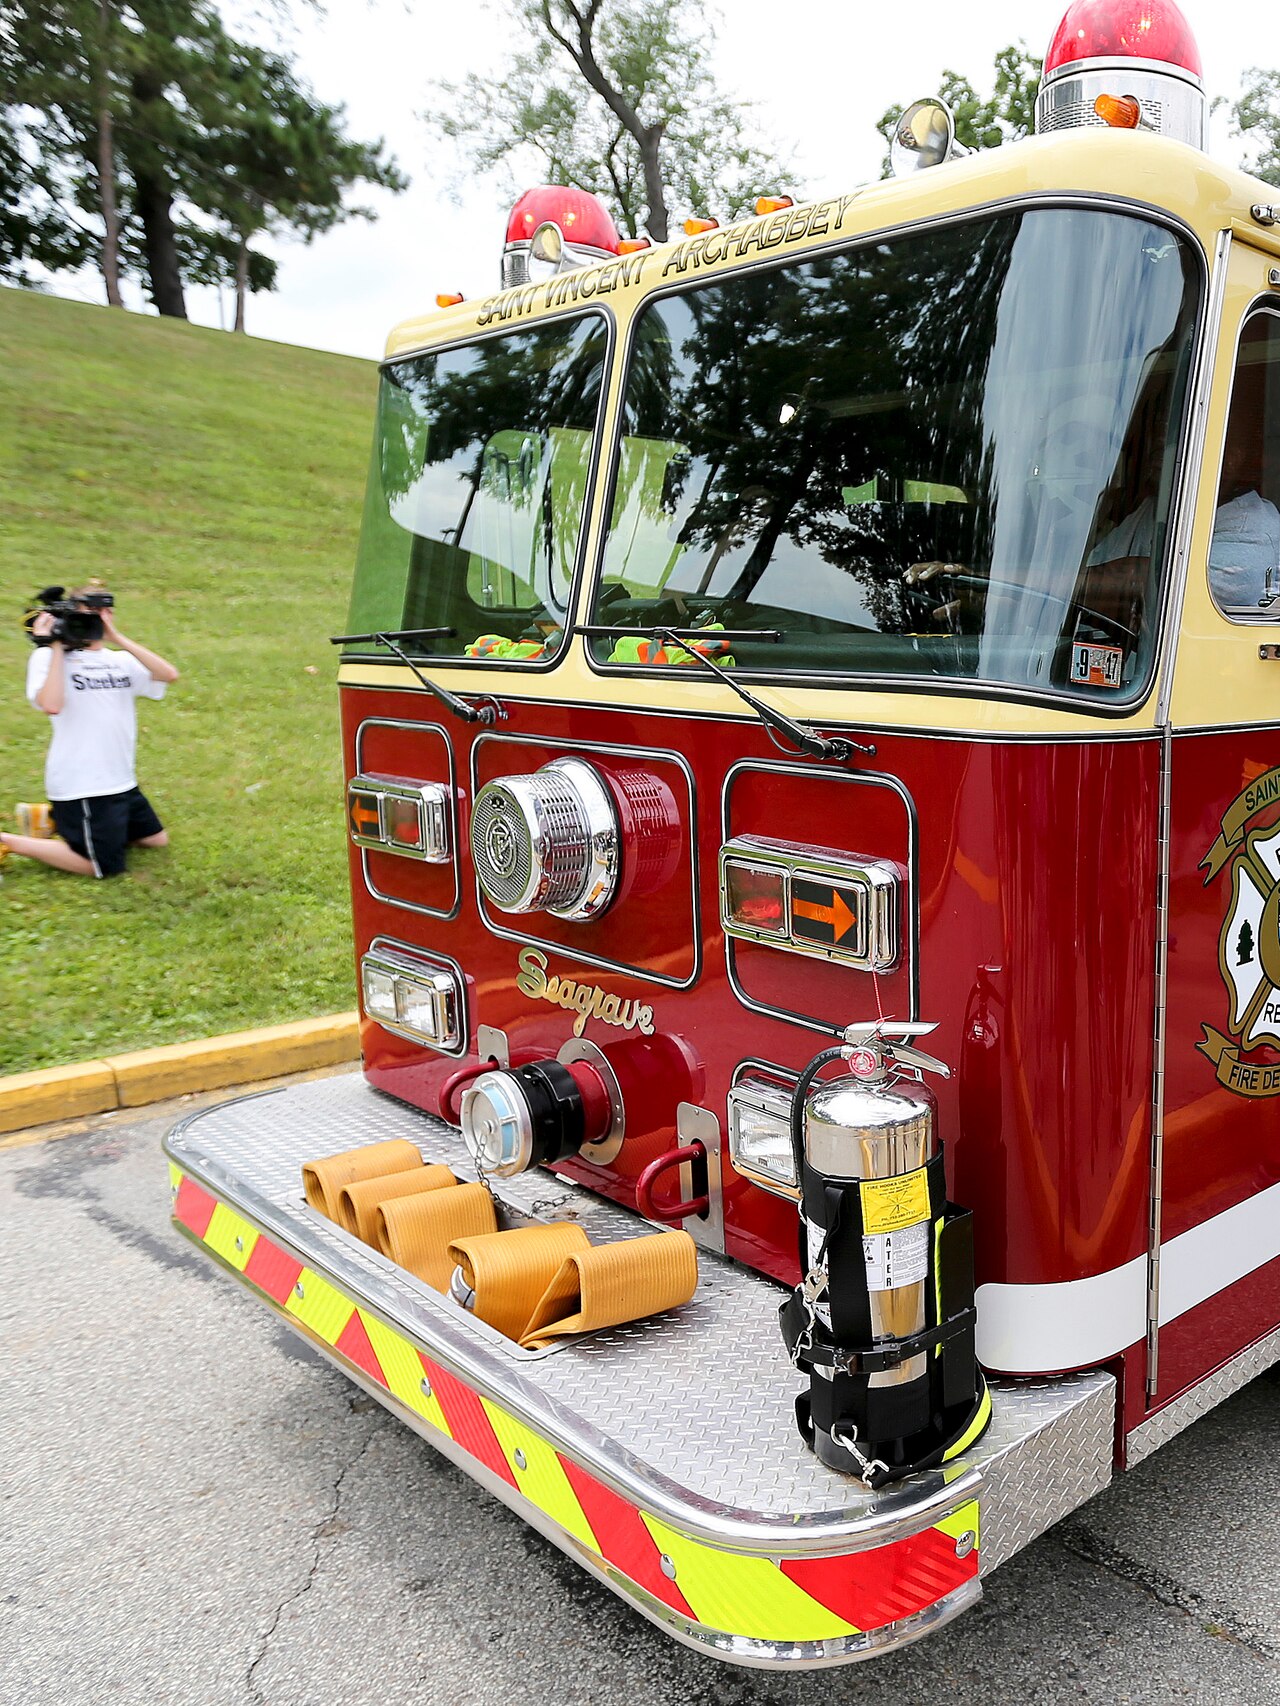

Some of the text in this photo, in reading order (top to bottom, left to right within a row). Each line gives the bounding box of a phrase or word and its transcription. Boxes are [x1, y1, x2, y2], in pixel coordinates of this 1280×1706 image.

[477, 190, 864, 326] SAINT VINCENT ARCHABBEY
[1080, 649, 1119, 679] 9 17
[516, 946, 656, 1038] Seagrave
[1228, 1065, 1260, 1090] FIRE
